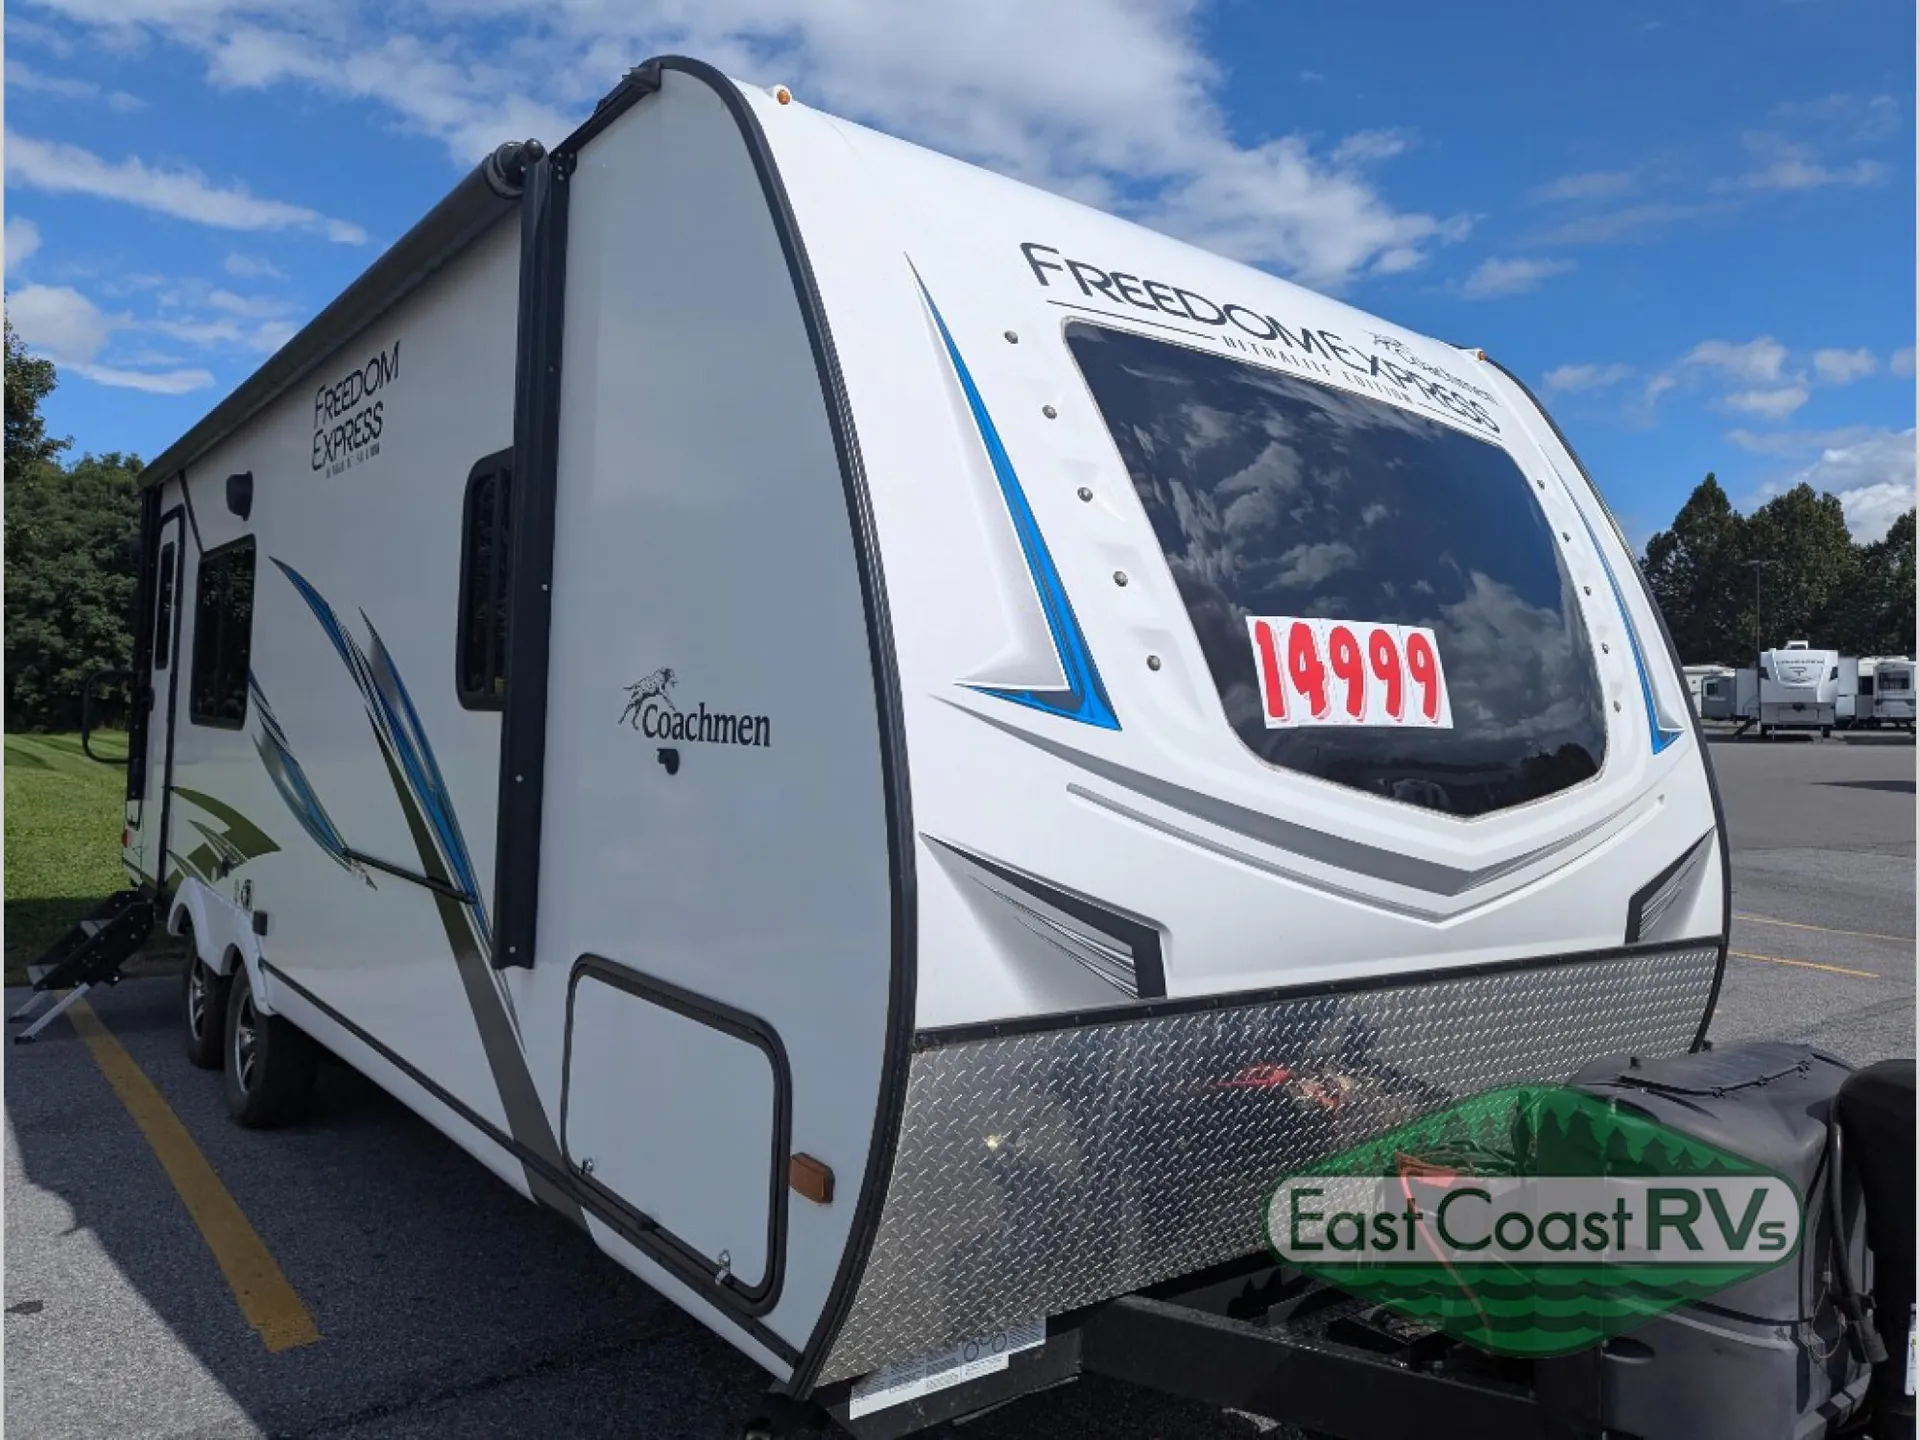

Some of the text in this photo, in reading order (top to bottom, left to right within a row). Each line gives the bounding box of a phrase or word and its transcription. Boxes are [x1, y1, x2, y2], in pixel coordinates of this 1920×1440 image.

[313, 339, 400, 430] FREEDOM
[311, 400, 384, 471] EXPRESS
[1254, 619, 1438, 724] 14999
[642, 701, 772, 748] Coachmen
